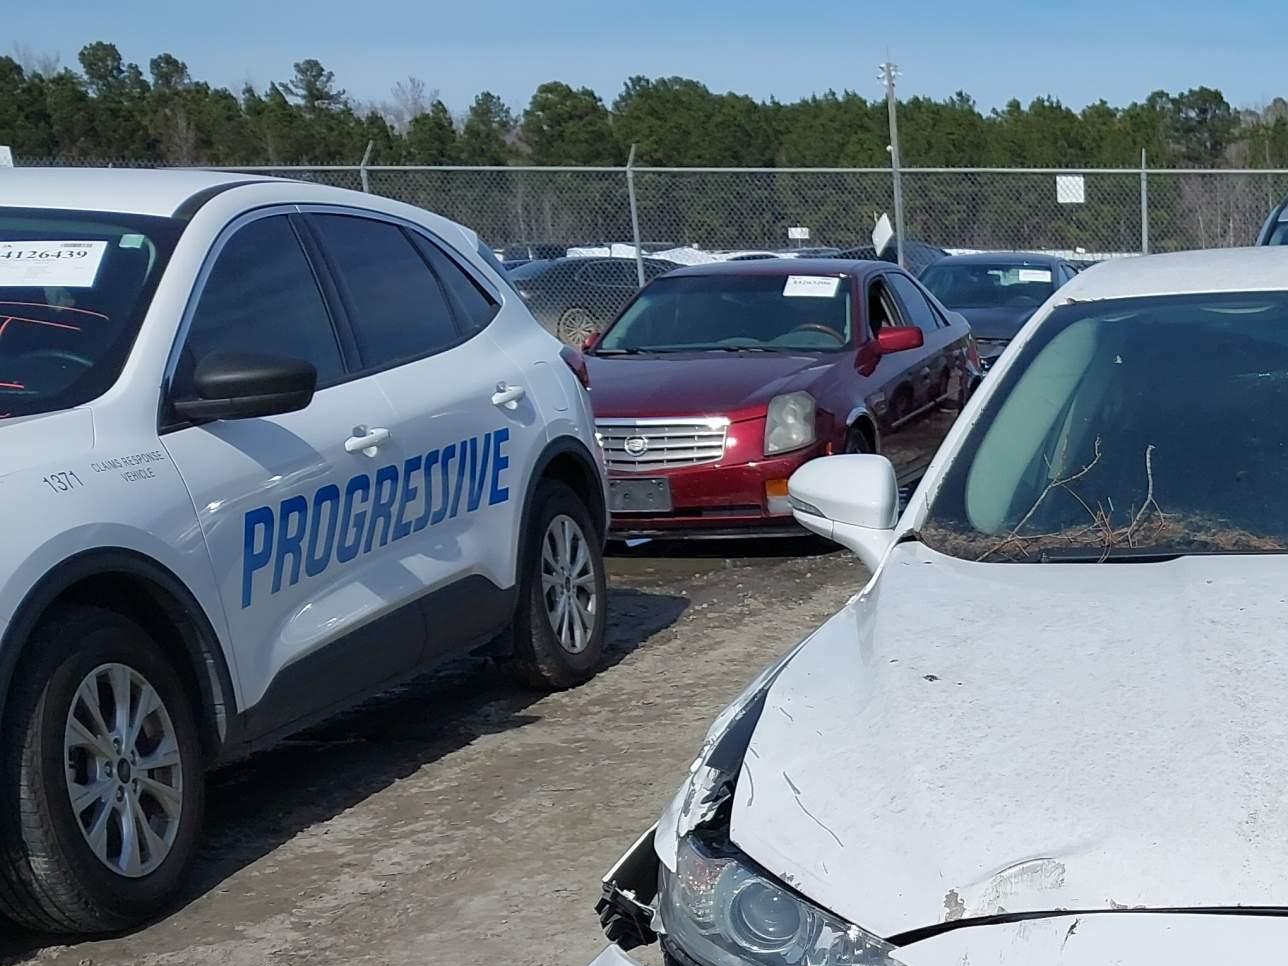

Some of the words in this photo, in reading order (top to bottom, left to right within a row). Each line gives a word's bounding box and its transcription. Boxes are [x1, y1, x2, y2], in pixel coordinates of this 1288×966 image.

[91, 459, 123, 473] CLAIMS
[121, 451, 166, 467] RESPONSE
[43, 470, 84, 493] 1371
[121, 467, 157, 482] VEHICLE
[242, 427, 509, 609] PROGRESSIVE
